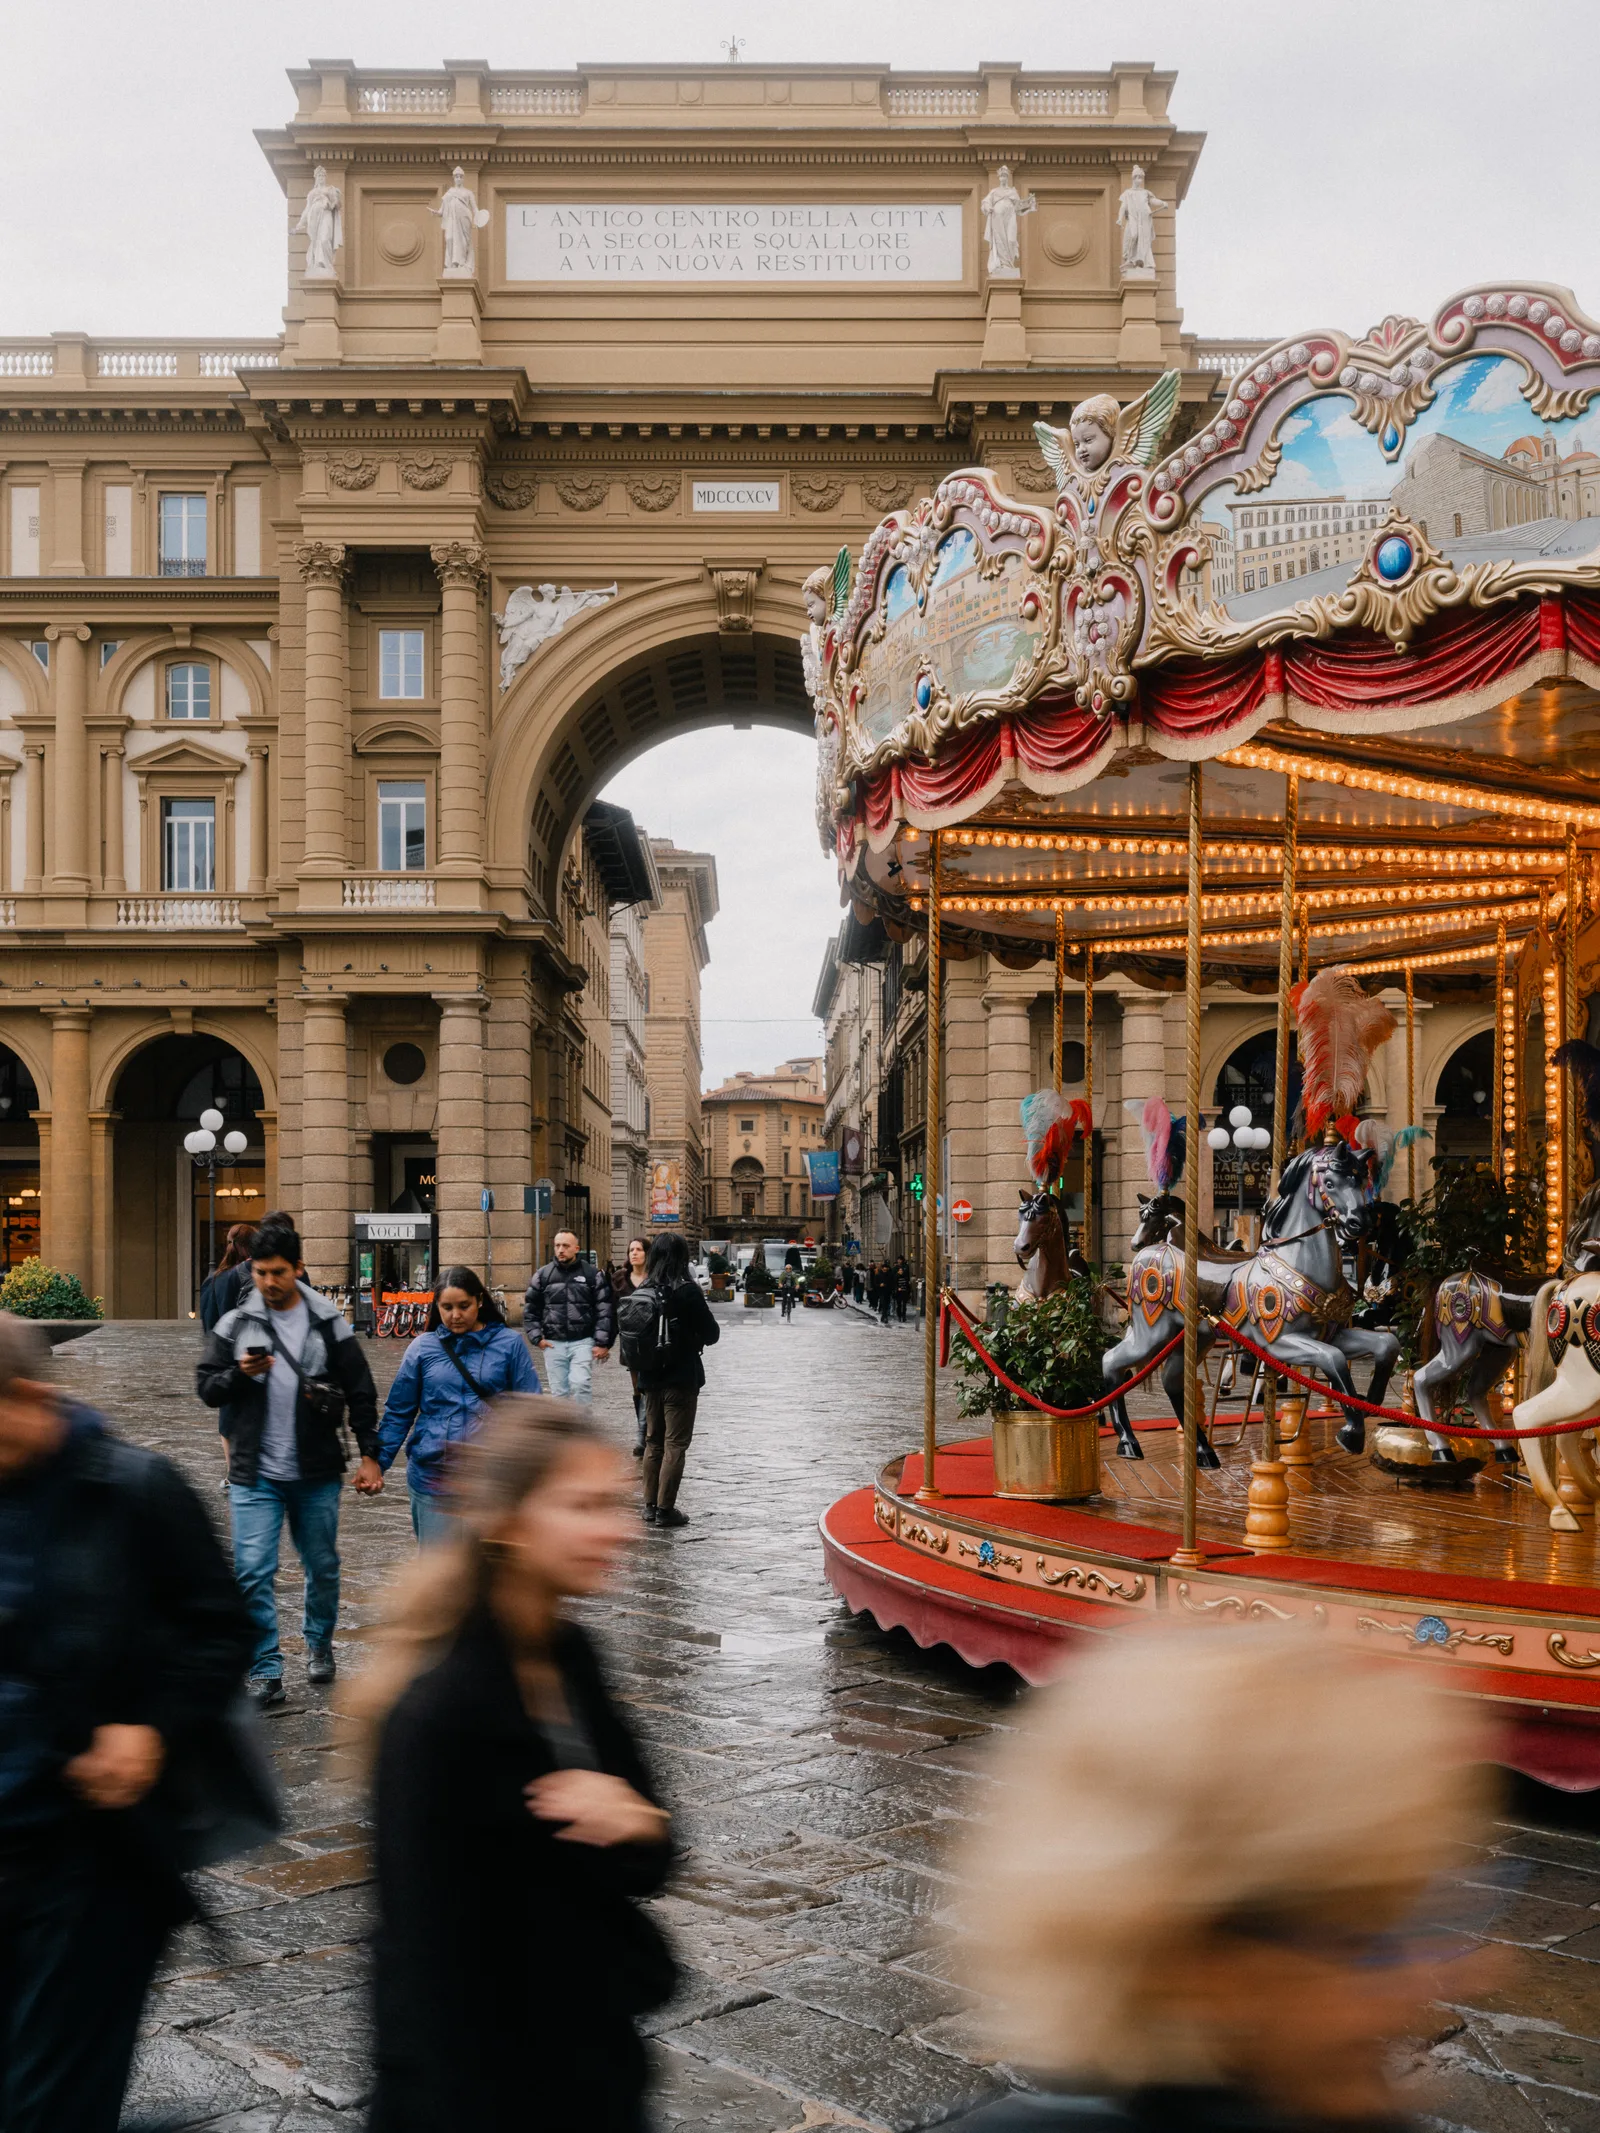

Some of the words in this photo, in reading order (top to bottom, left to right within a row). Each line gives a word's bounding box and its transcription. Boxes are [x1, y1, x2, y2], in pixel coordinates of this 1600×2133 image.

[522, 210, 538, 227] L'
[550, 210, 643, 227] ANTICO
[654, 210, 759, 227] CENTRO
[771, 210, 858, 227] DELLA
[870, 210, 948, 227] CITTÀ
[558, 232, 592, 249] DA
[603, 232, 741, 249] SECOLARE
[753, 232, 911, 250] SQUALLORE
[559, 255, 573, 271] A
[586, 255, 644, 271] VITA
[656, 254, 743, 271] NUOVA
[756, 254, 911, 271] RESTITUITO
[697, 490, 774, 504] MDCCCXCV
[3, 1216, 40, 1229] PR
[370, 1226, 415, 1238] VOGUE
